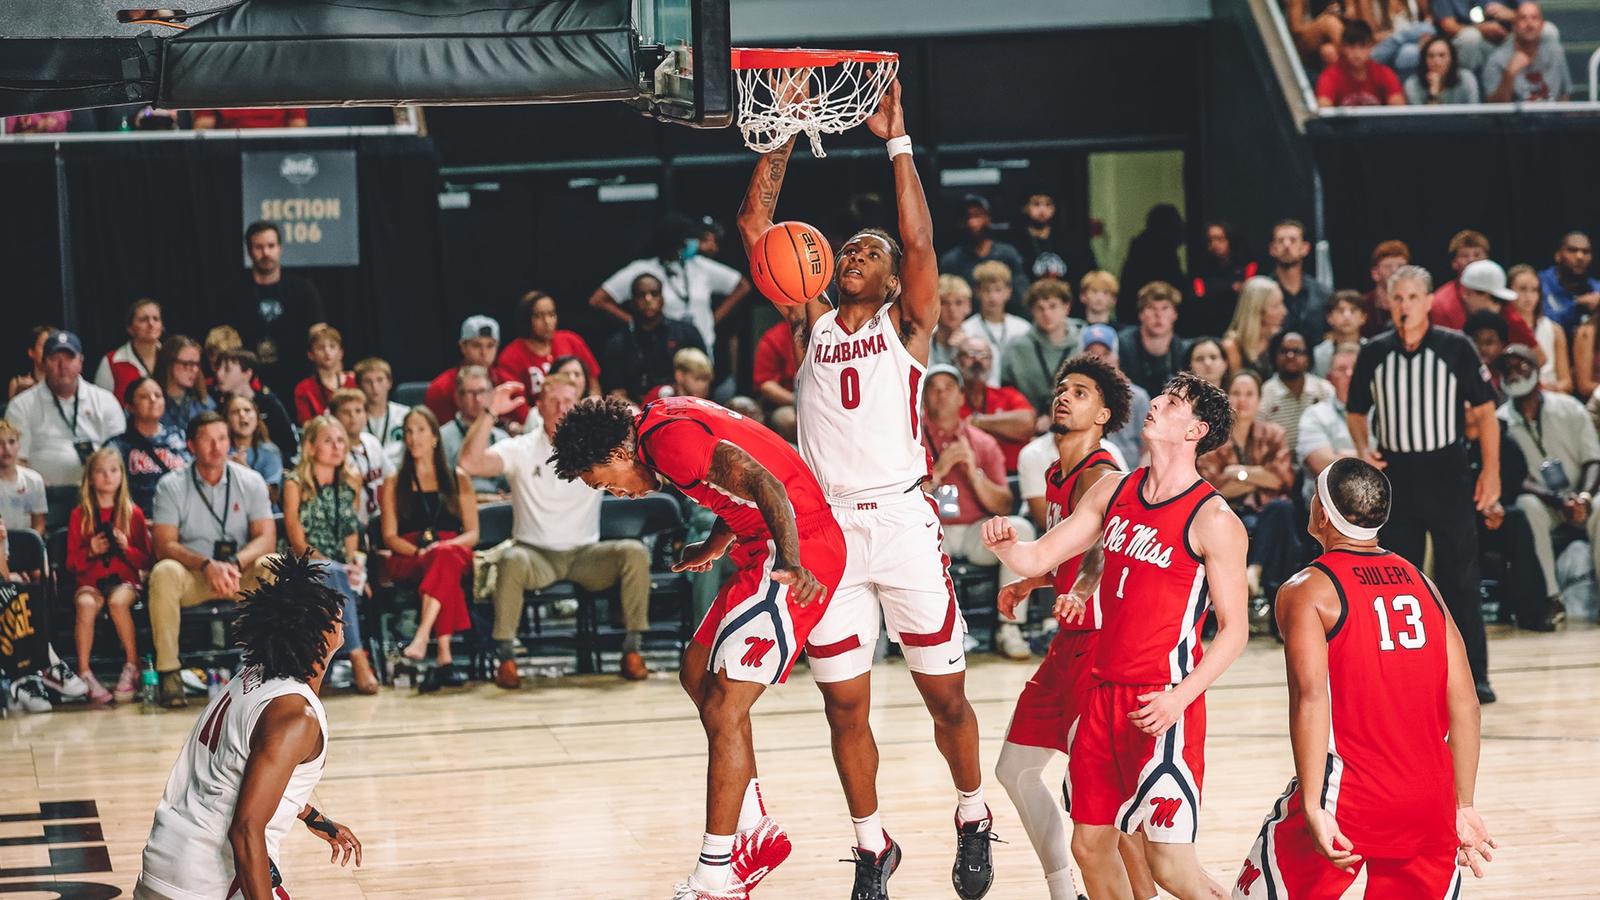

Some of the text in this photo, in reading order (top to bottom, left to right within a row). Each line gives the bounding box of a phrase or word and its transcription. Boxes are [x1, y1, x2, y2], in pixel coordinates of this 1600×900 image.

[261, 199, 341, 220] SECTION
[284, 222, 321, 243] 106
[802, 232, 821, 275] ELITE
[814, 333, 888, 364] ALABAMA
[840, 366, 861, 410] 0
[856, 502, 878, 511] RTR
[1103, 515, 1130, 553] Ole
[1124, 523, 1174, 569] Miss
[1116, 566, 1130, 599] 1
[1352, 565, 1415, 586] SIULEPA
[1373, 594, 1428, 651] 13
